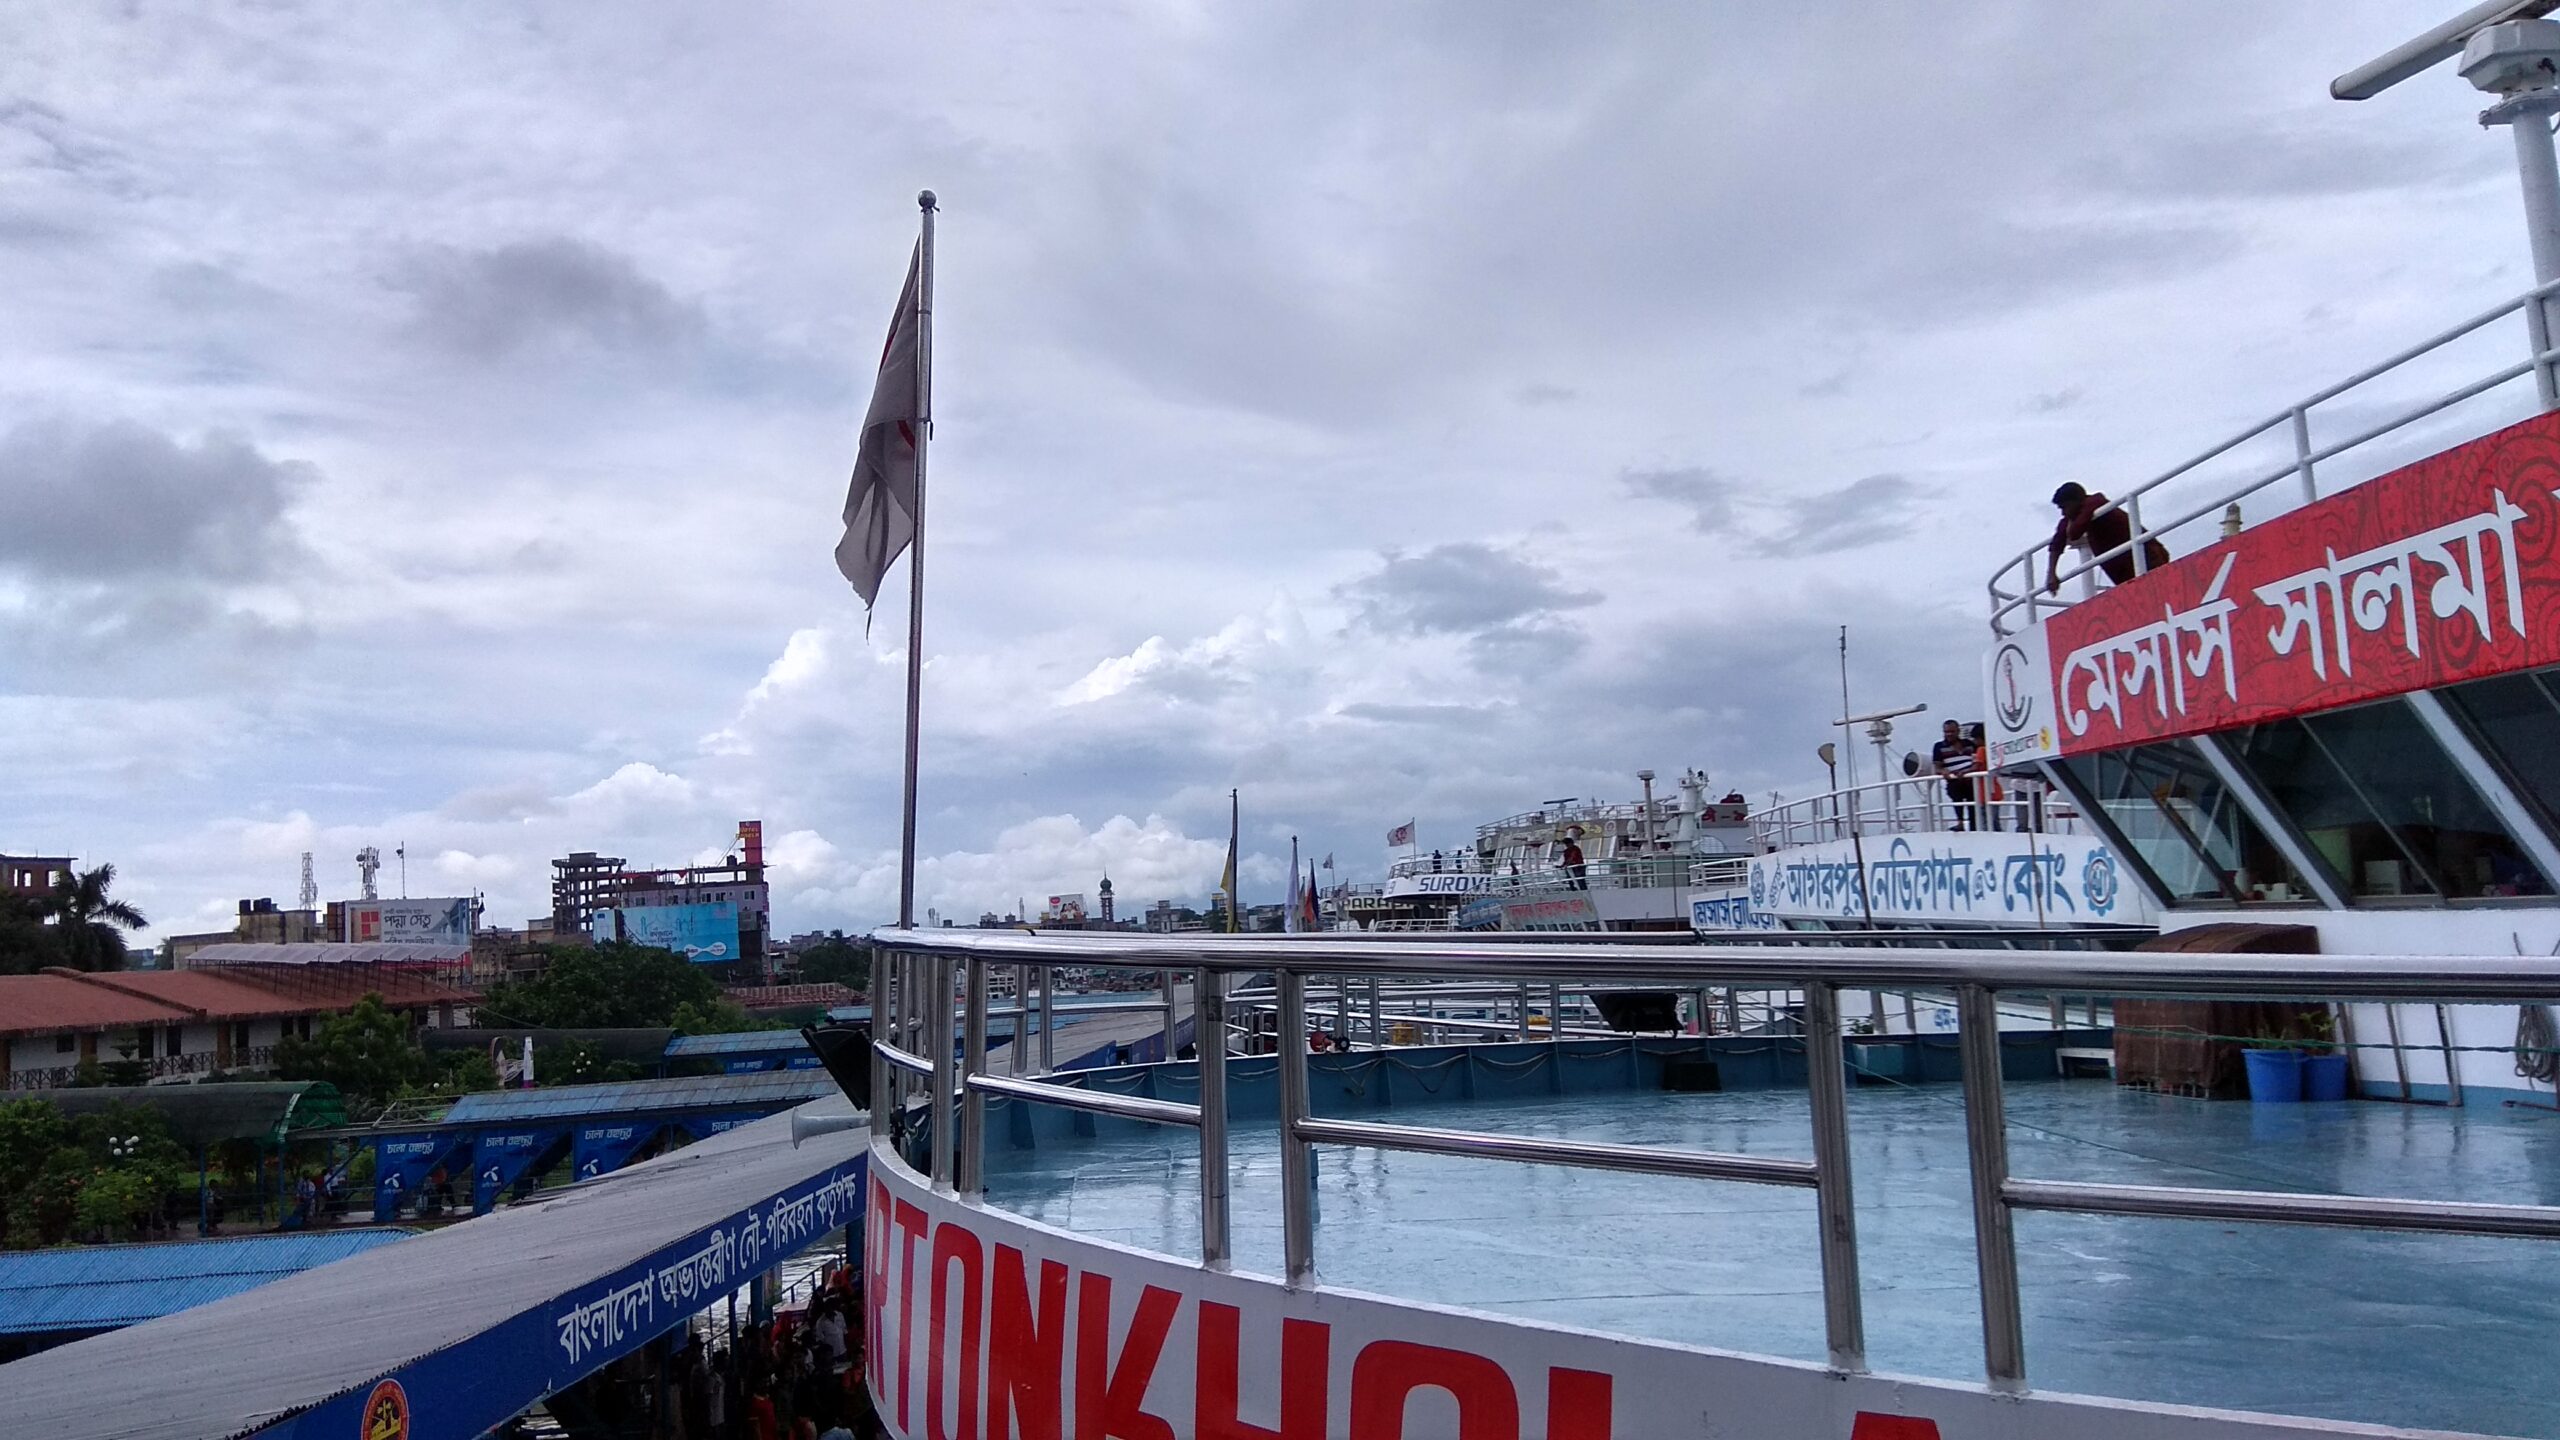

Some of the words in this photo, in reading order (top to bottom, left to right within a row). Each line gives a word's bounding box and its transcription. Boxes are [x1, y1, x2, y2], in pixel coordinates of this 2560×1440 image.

[2061, 551, 2239, 737] মেসার্স
[2253, 488, 2529, 682] সালমা
[1418, 876, 1492, 893] SUROVI
[1786, 852, 1867, 916] আগরপুর
[2003, 844, 2076, 915] কোং
[1343, 896, 1412, 909] PARA
[384, 914, 407, 928] পদ্মা
[410, 914, 432, 929] সেতু
[486, 1136, 505, 1148] চলো
[585, 1129, 605, 1140] চলো
[387, 1143, 406, 1154] চলো
[557, 1268, 655, 1365] বাংলাদেশ
[658, 1227, 736, 1309] অভ্যন্তরীণ
[739, 1196, 814, 1270] নৌ-পরিবহন
[815, 1170, 857, 1231] কর্তৃপক্ষ
